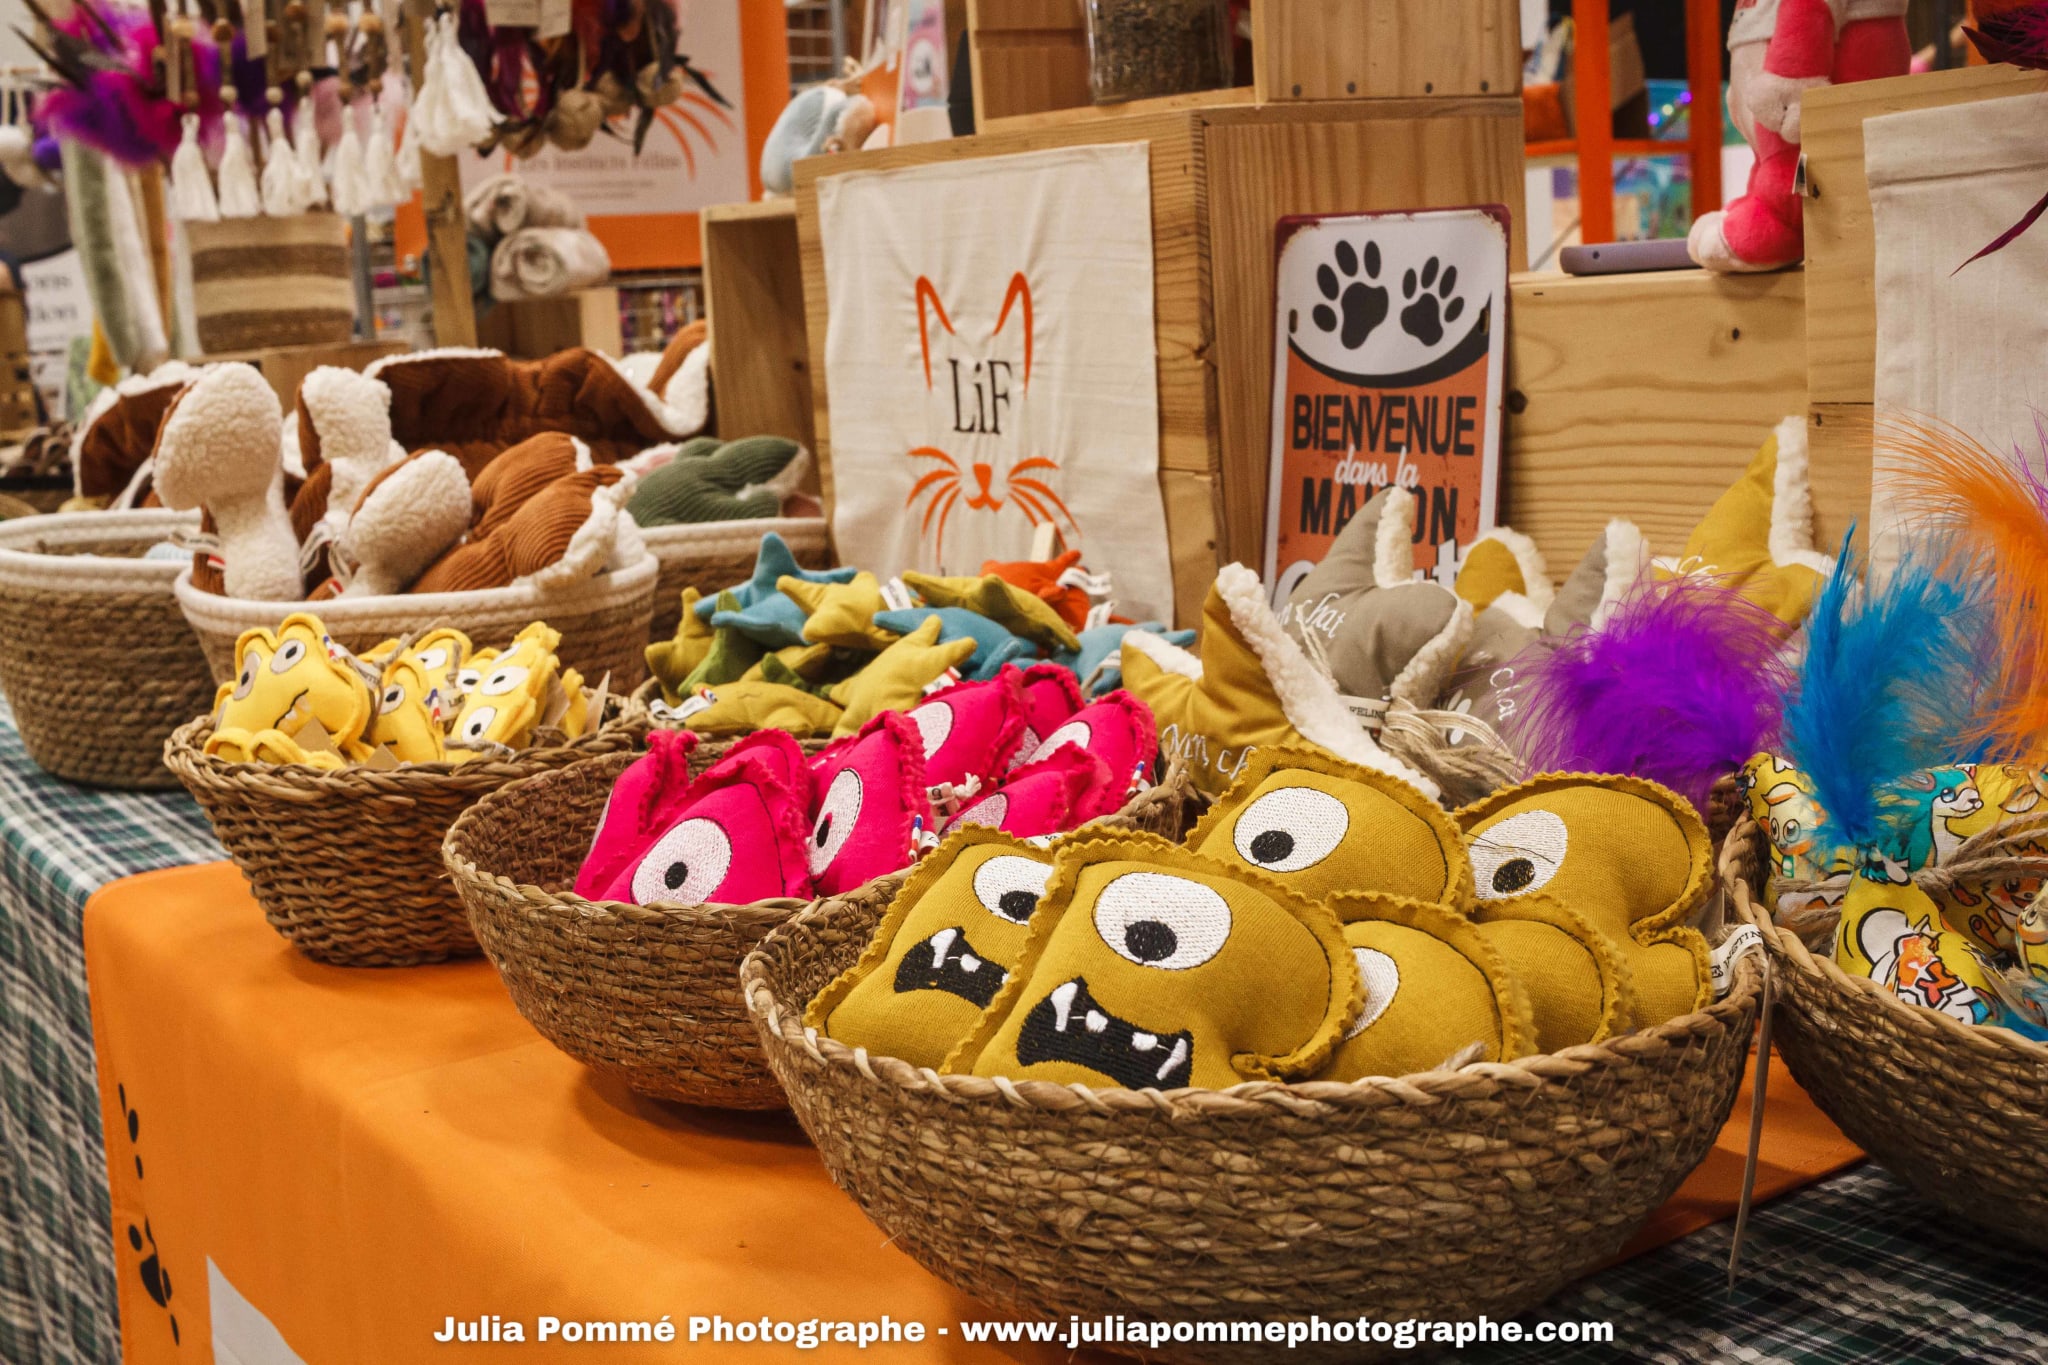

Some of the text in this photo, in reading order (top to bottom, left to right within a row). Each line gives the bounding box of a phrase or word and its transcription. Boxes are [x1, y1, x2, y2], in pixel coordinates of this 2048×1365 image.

[947, 358, 1013, 435] LiF
[1292, 394, 1478, 456] BIENVENUE
[1333, 443, 1421, 488] dans la
